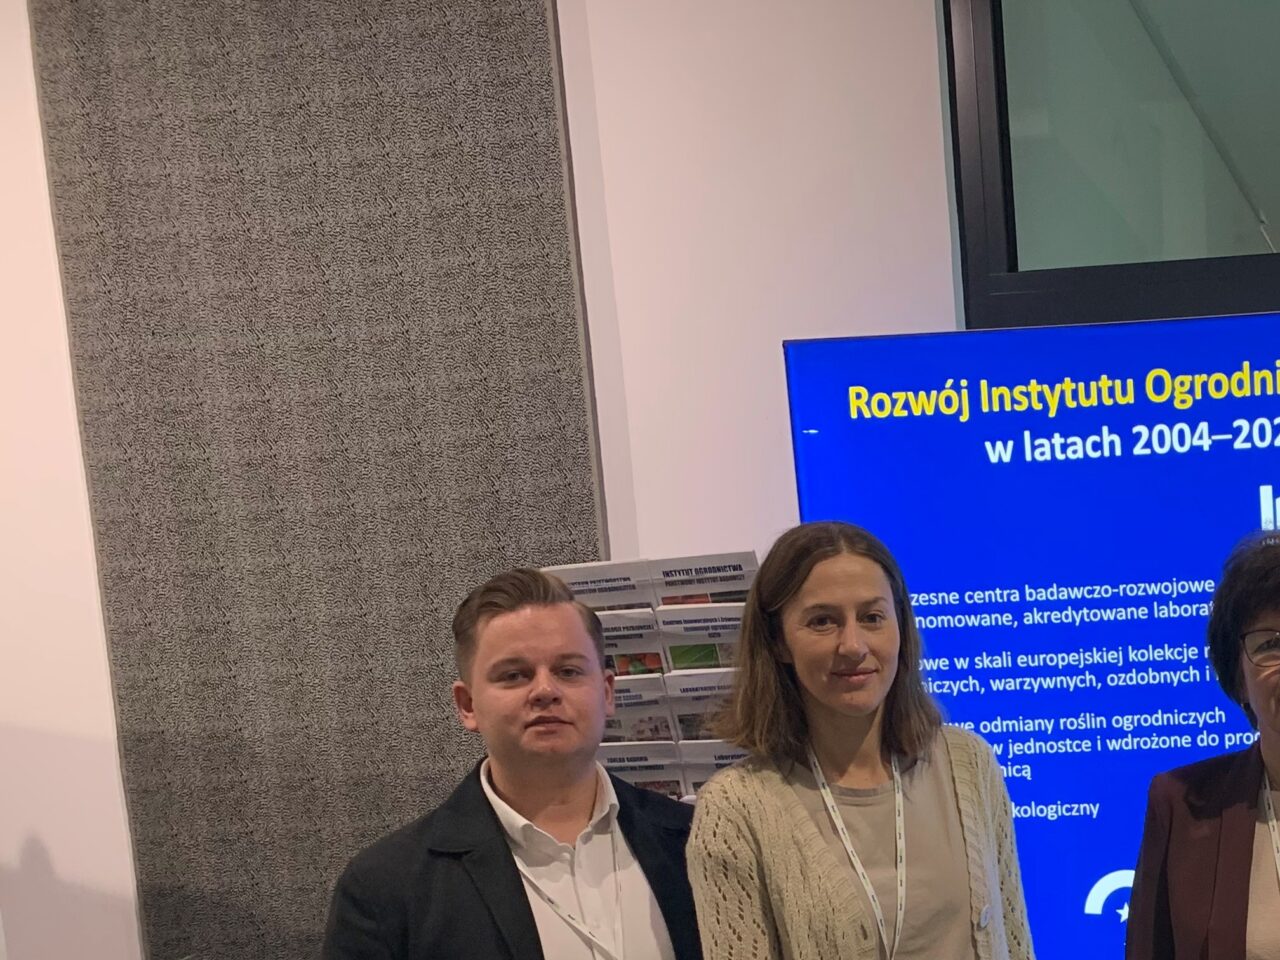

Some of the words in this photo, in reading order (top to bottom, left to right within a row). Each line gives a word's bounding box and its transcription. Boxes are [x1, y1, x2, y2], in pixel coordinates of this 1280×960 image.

[849, 379, 969, 422] Rozwój
[980, 375, 1135, 418] Instytutu
[985, 440, 1013, 463] w
[1023, 426, 1122, 462] latach
[911, 593, 959, 606] zesne
[964, 587, 1020, 604] centra
[1025, 578, 1215, 602] badawczo-rozwojowe
[915, 612, 1018, 629] nomowane,
[1023, 603, 1149, 627] akredytowane
[954, 656, 969, 669] w
[975, 651, 1012, 669] skali
[1017, 646, 1123, 671] europejskiej
[1128, 643, 1199, 668] kolekcje
[990, 669, 1102, 693] warzywnych,
[1107, 665, 1202, 688] ozdobnych
[980, 715, 1053, 736] odmiany
[1059, 711, 1107, 731] roślin
[1112, 706, 1226, 732] ogrodniczych
[1008, 735, 1092, 759] jednostce
[1097, 735, 1102, 751] i
[1106, 732, 1192, 750] wdrożone
[1197, 730, 1219, 747] do
[1012, 802, 1100, 821] kologiczny
